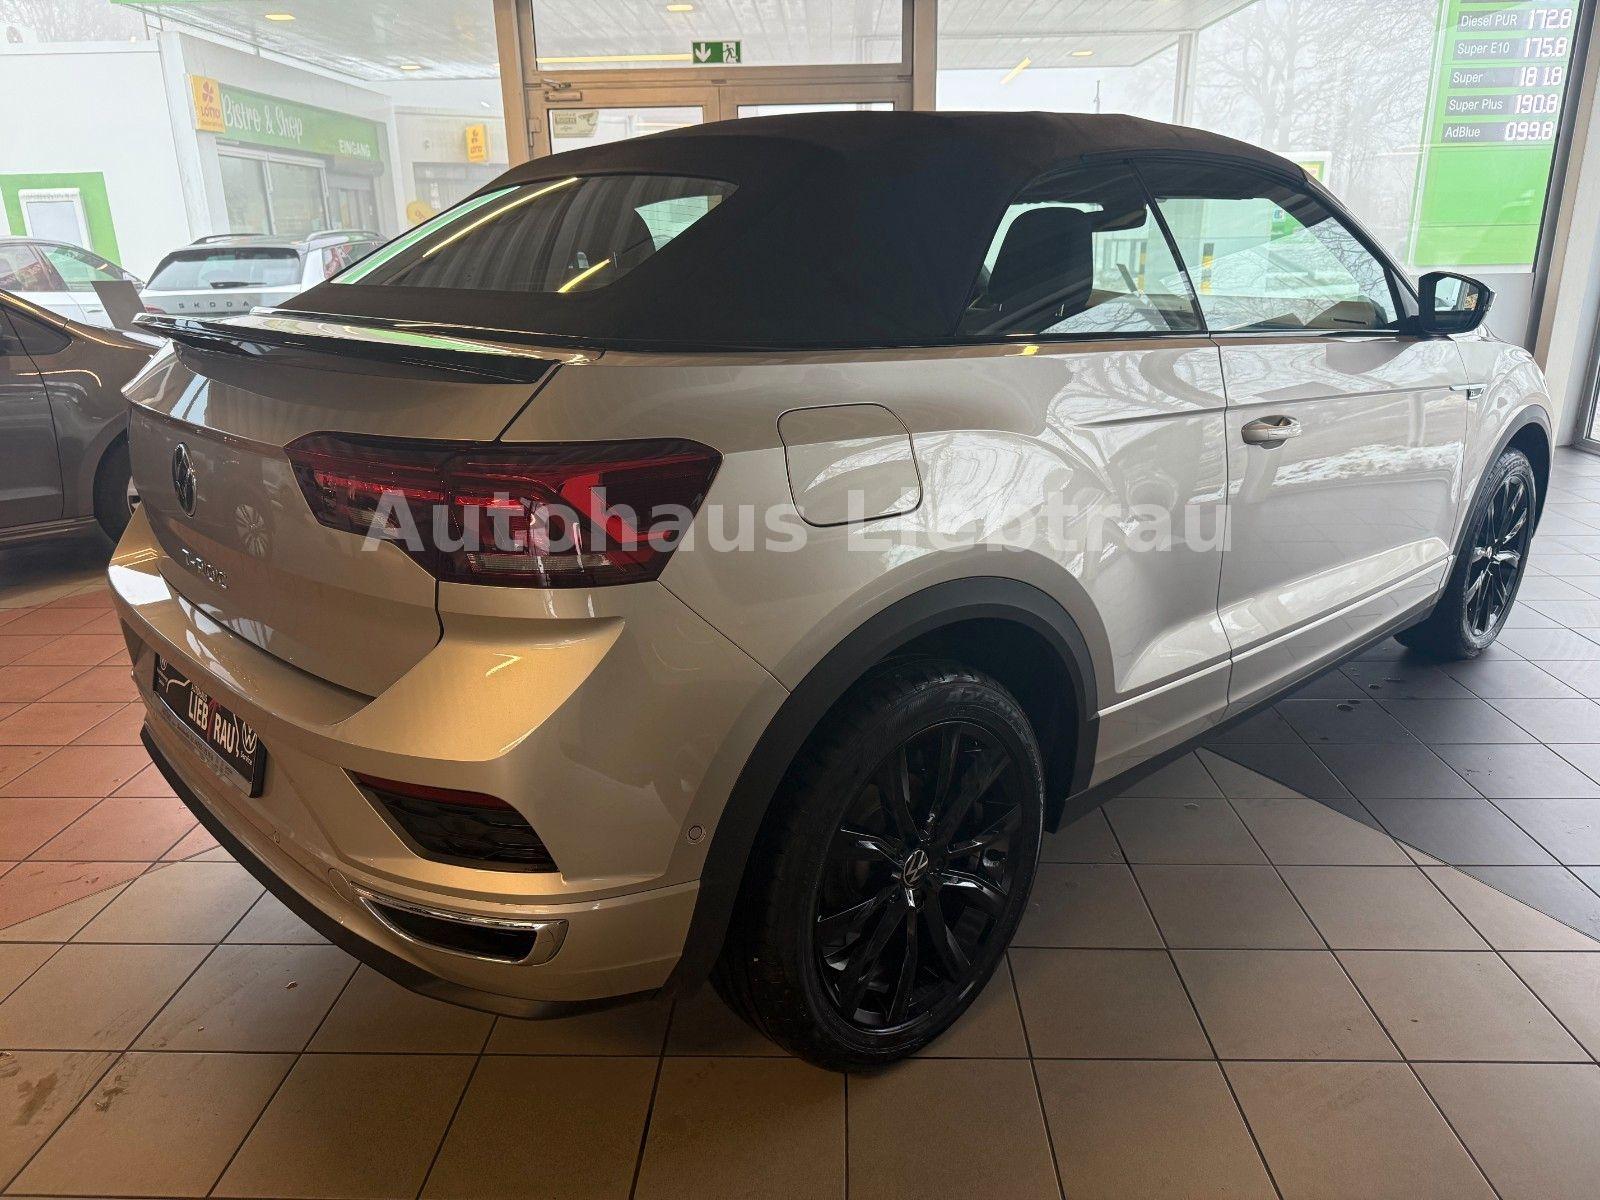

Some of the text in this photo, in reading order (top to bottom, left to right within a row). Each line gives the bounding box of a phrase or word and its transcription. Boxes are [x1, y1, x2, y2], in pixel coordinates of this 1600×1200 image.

[1460, 14, 1492, 27] Diesel
[1495, 13, 1518, 26] PUR
[1456, 43, 1489, 56] Super
[1491, 41, 1510, 54] E10
[1452, 72, 1483, 84] Super
[1449, 99, 1479, 112] Super
[1481, 98, 1503, 110] Plus
[221, 93, 303, 144] Bistro & Shop
[1444, 126, 1481, 138] AdBlue
[338, 138, 371, 158] EINGANG
